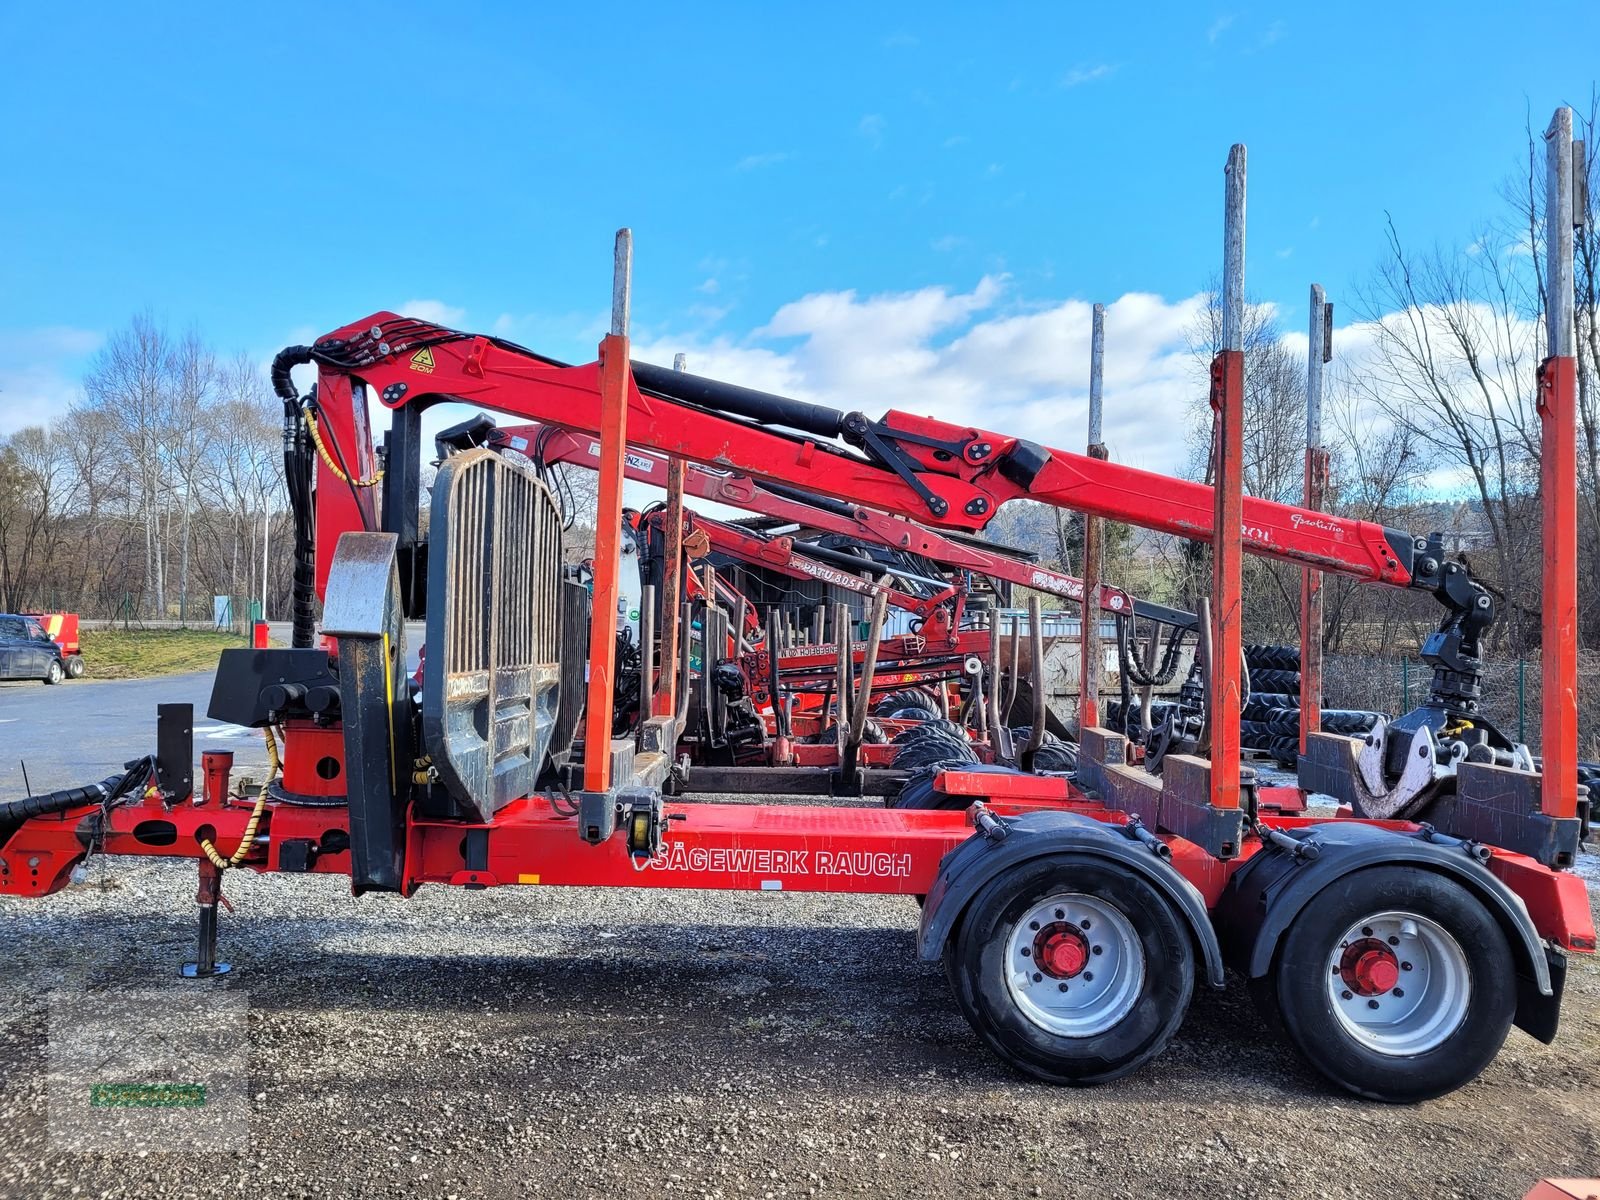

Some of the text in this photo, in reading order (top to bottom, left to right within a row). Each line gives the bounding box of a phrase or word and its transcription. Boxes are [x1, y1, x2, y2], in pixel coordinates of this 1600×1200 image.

[409, 363, 434, 374] 20M
[650, 841, 911, 877] SÄGEWERK RAUCH
